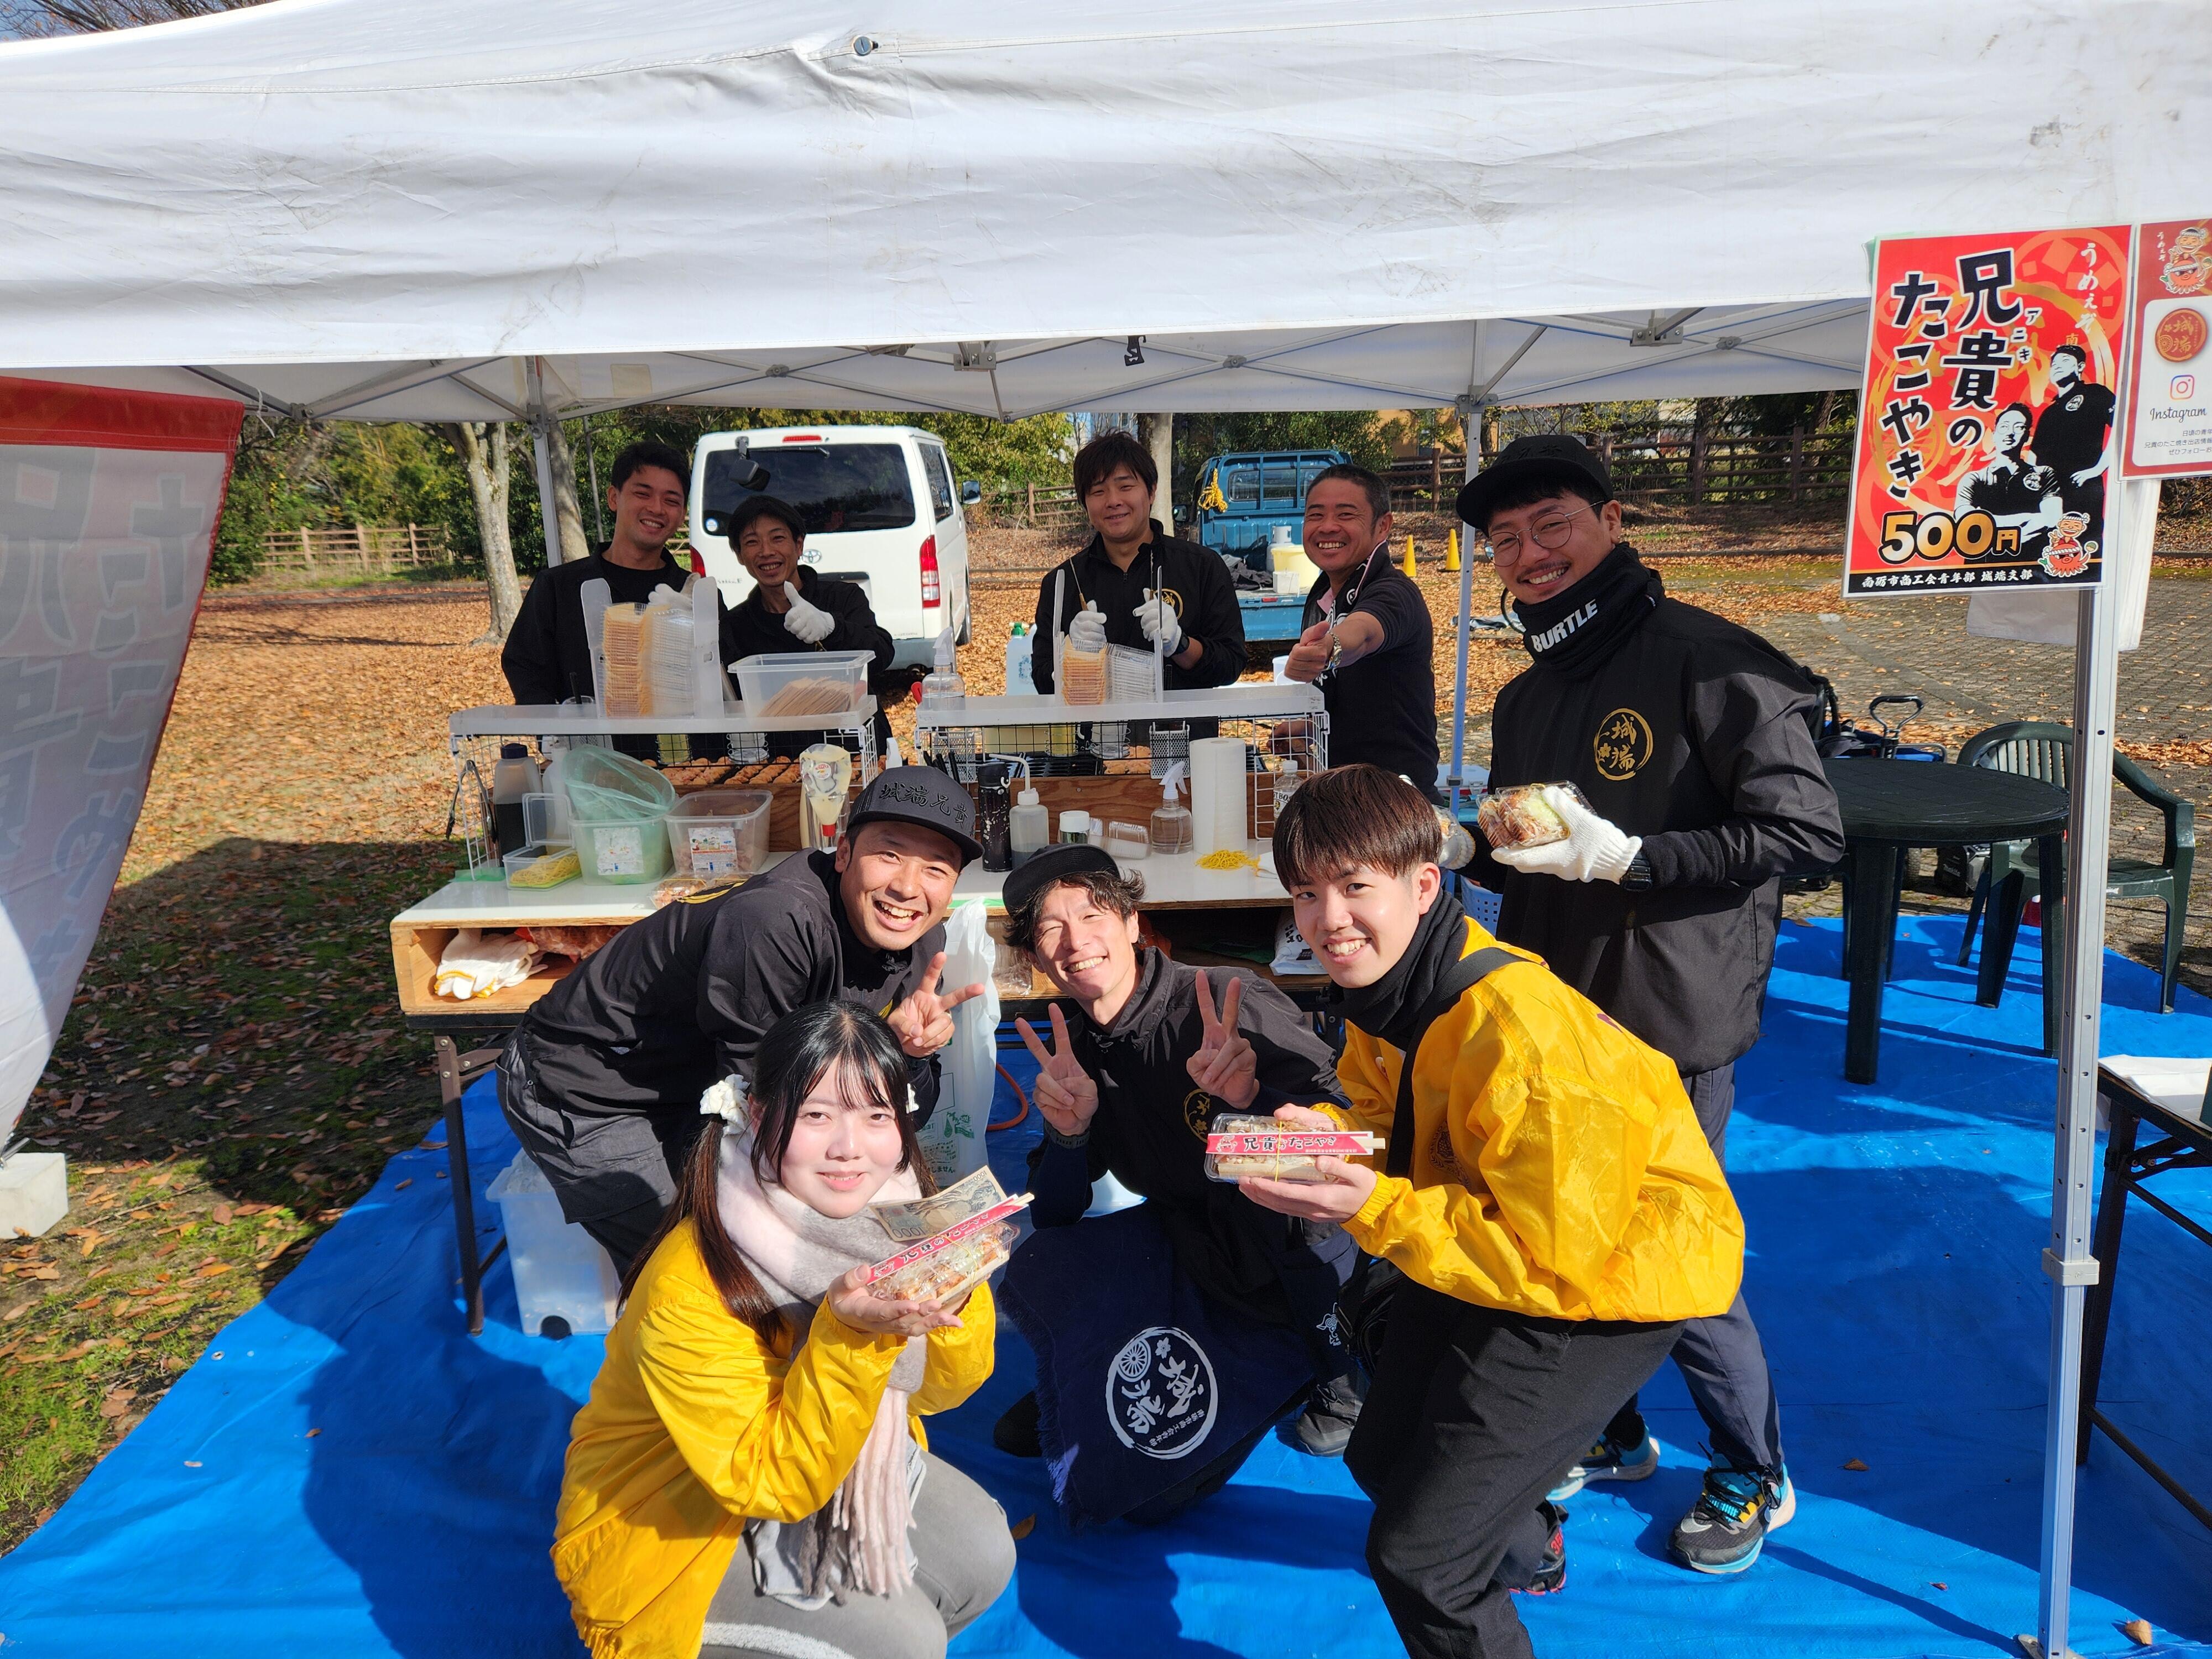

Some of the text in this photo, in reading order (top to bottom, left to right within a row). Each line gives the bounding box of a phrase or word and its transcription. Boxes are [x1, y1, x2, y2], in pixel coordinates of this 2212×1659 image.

[1942, 248, 2022, 448] 兄貴の
[2011, 307, 2042, 364] アニキ
[1881, 271, 1952, 500] たこやき
[2150, 406, 2207, 423] Instagram
[1879, 510, 2022, 565] 500円
[1861, 568, 2033, 588] 南砺市商工会青年部 城端支部
[1531, 598, 1598, 653] BURTLE
